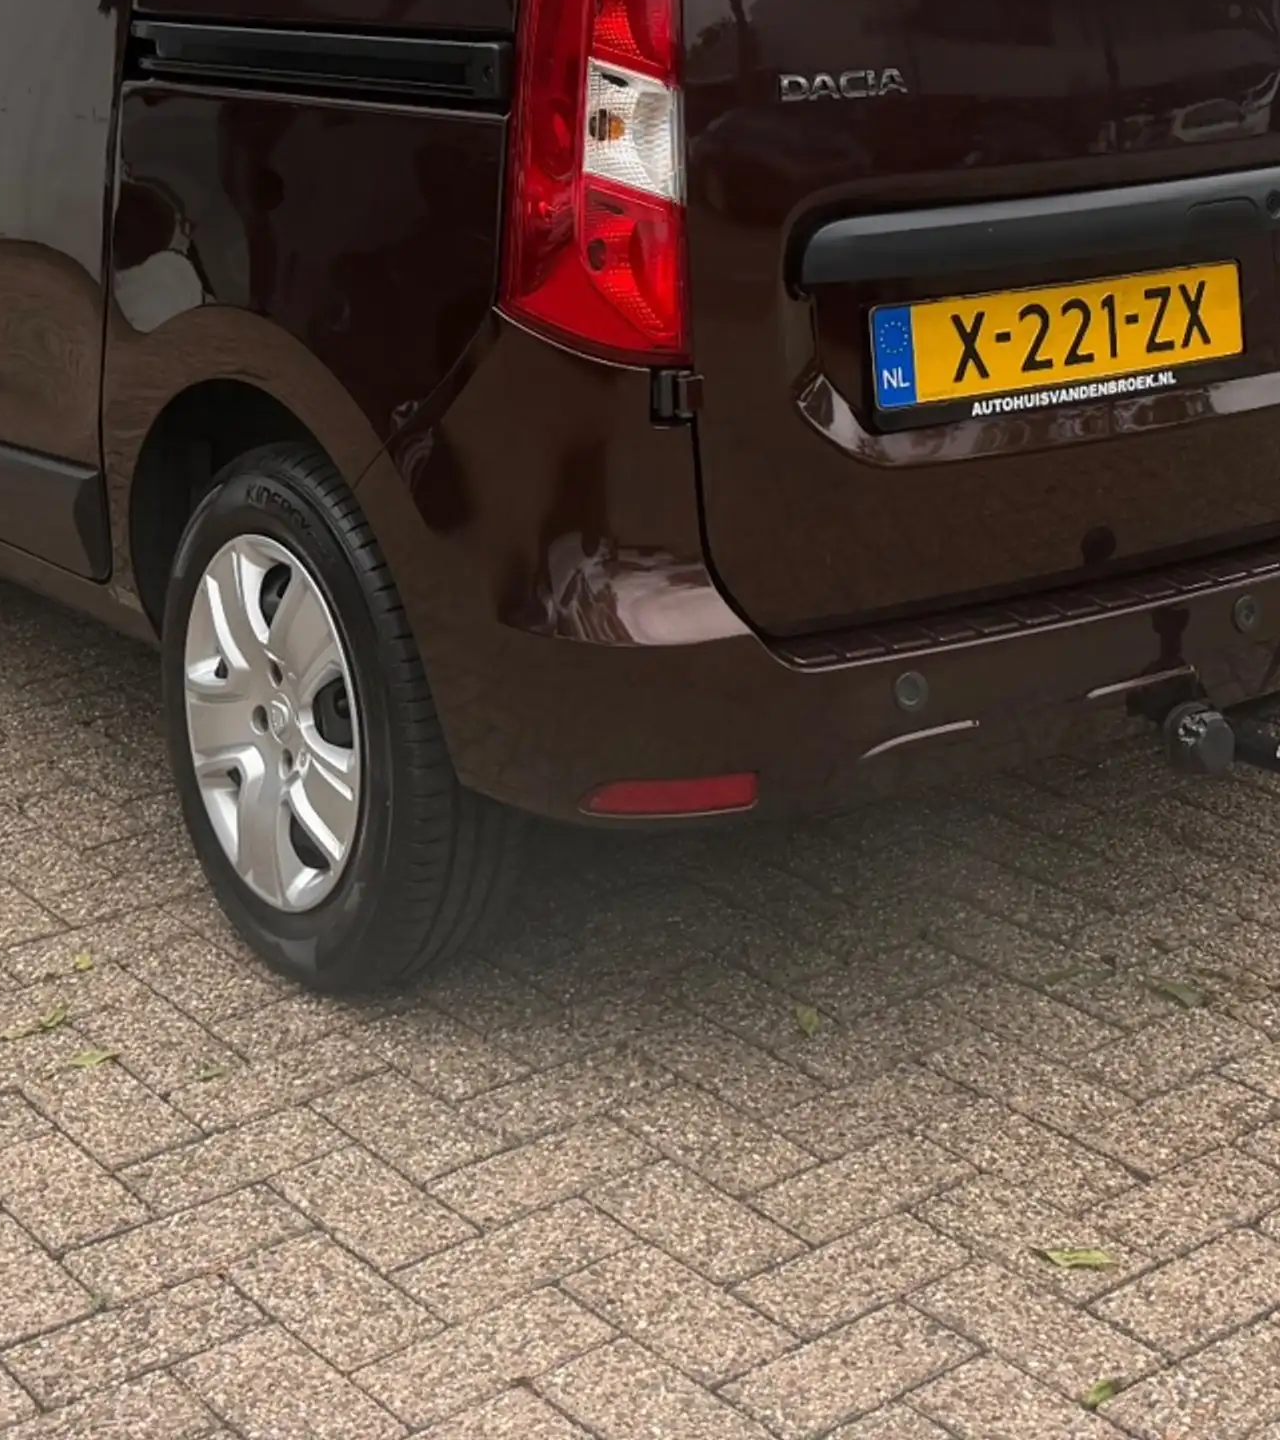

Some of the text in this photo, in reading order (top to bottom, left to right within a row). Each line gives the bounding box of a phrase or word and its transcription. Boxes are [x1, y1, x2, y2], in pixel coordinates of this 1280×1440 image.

[780, 68, 908, 101] DACIA
[950, 280, 1211, 383] X-221-ZX
[883, 368, 910, 390] NL
[972, 371, 1177, 417] AUTOHUISVANDENBROEK.NL
